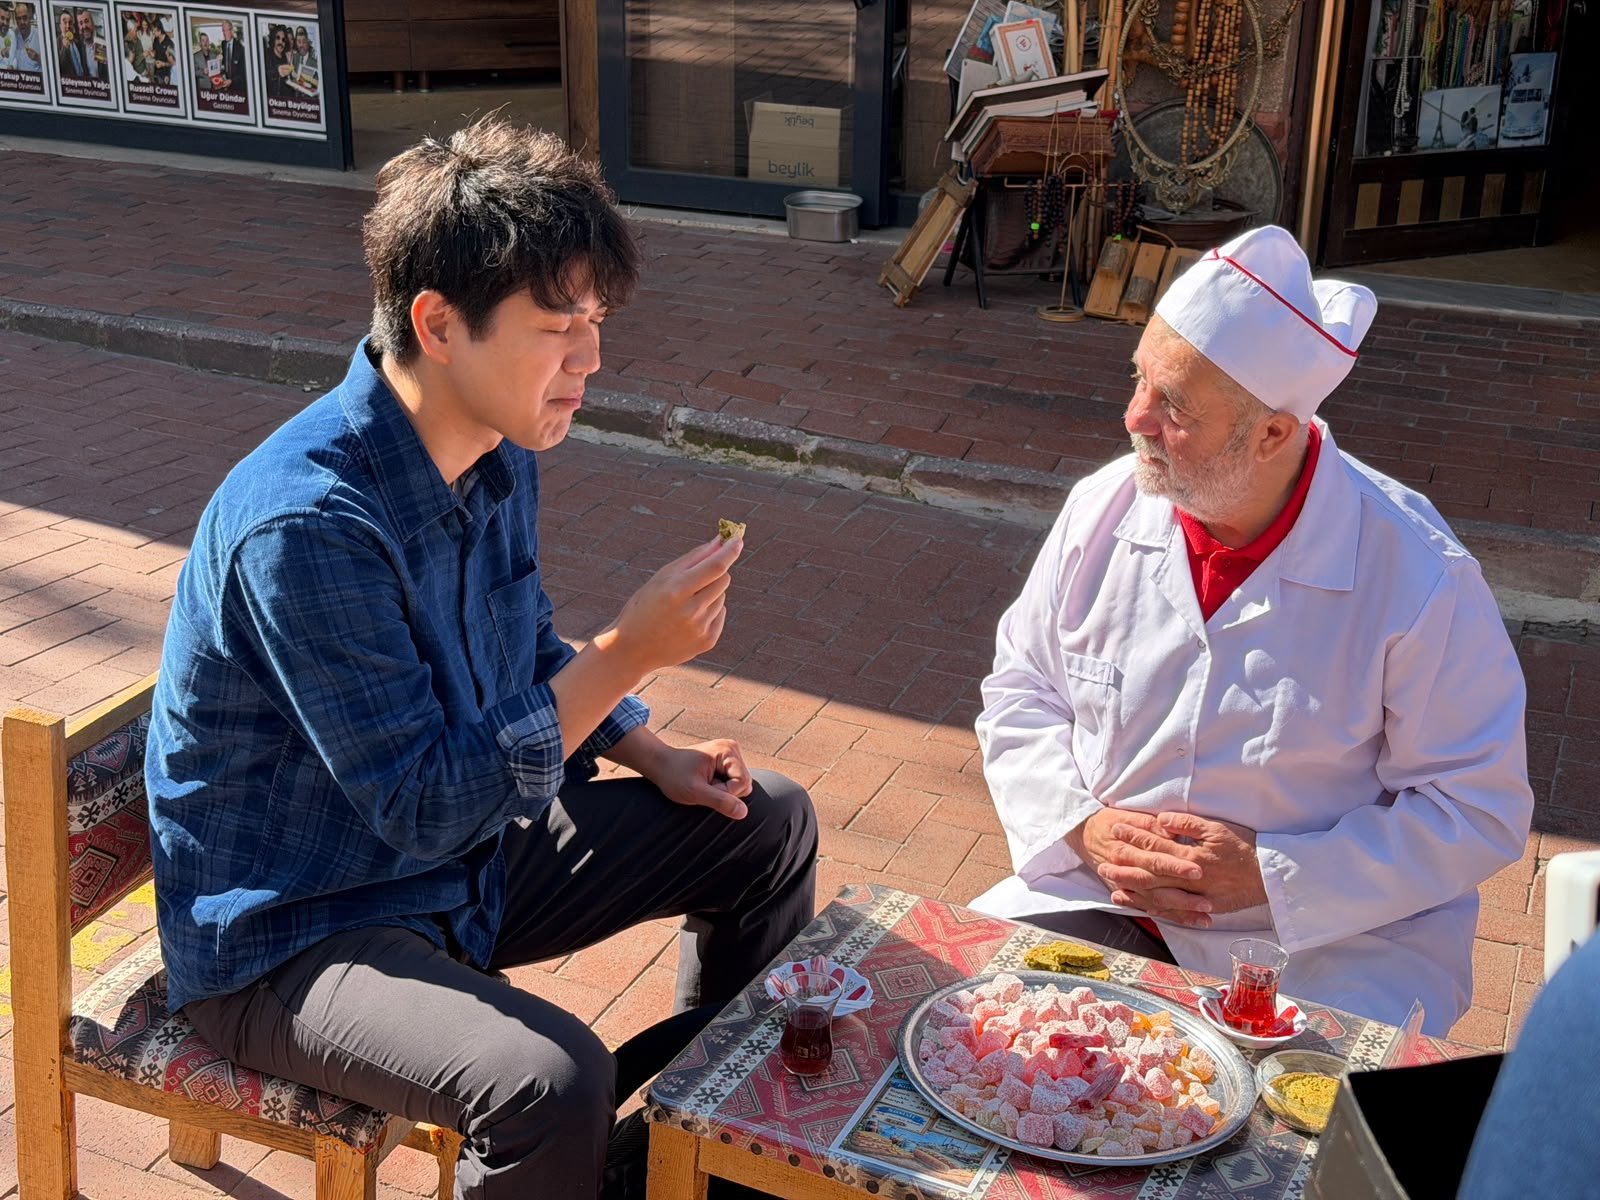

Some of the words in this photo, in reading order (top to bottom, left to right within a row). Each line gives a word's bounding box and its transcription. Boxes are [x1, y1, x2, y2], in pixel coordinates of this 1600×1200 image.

[129, 84, 154, 94] Russell
[155, 86, 178, 96] Crowe
[200, 91, 218, 101] Uğur
[219, 92, 246, 103] Dündar
[268, 98, 287, 108] Okan
[288, 100, 320, 112] Bayülgen
[768, 160, 815, 178] beylik
